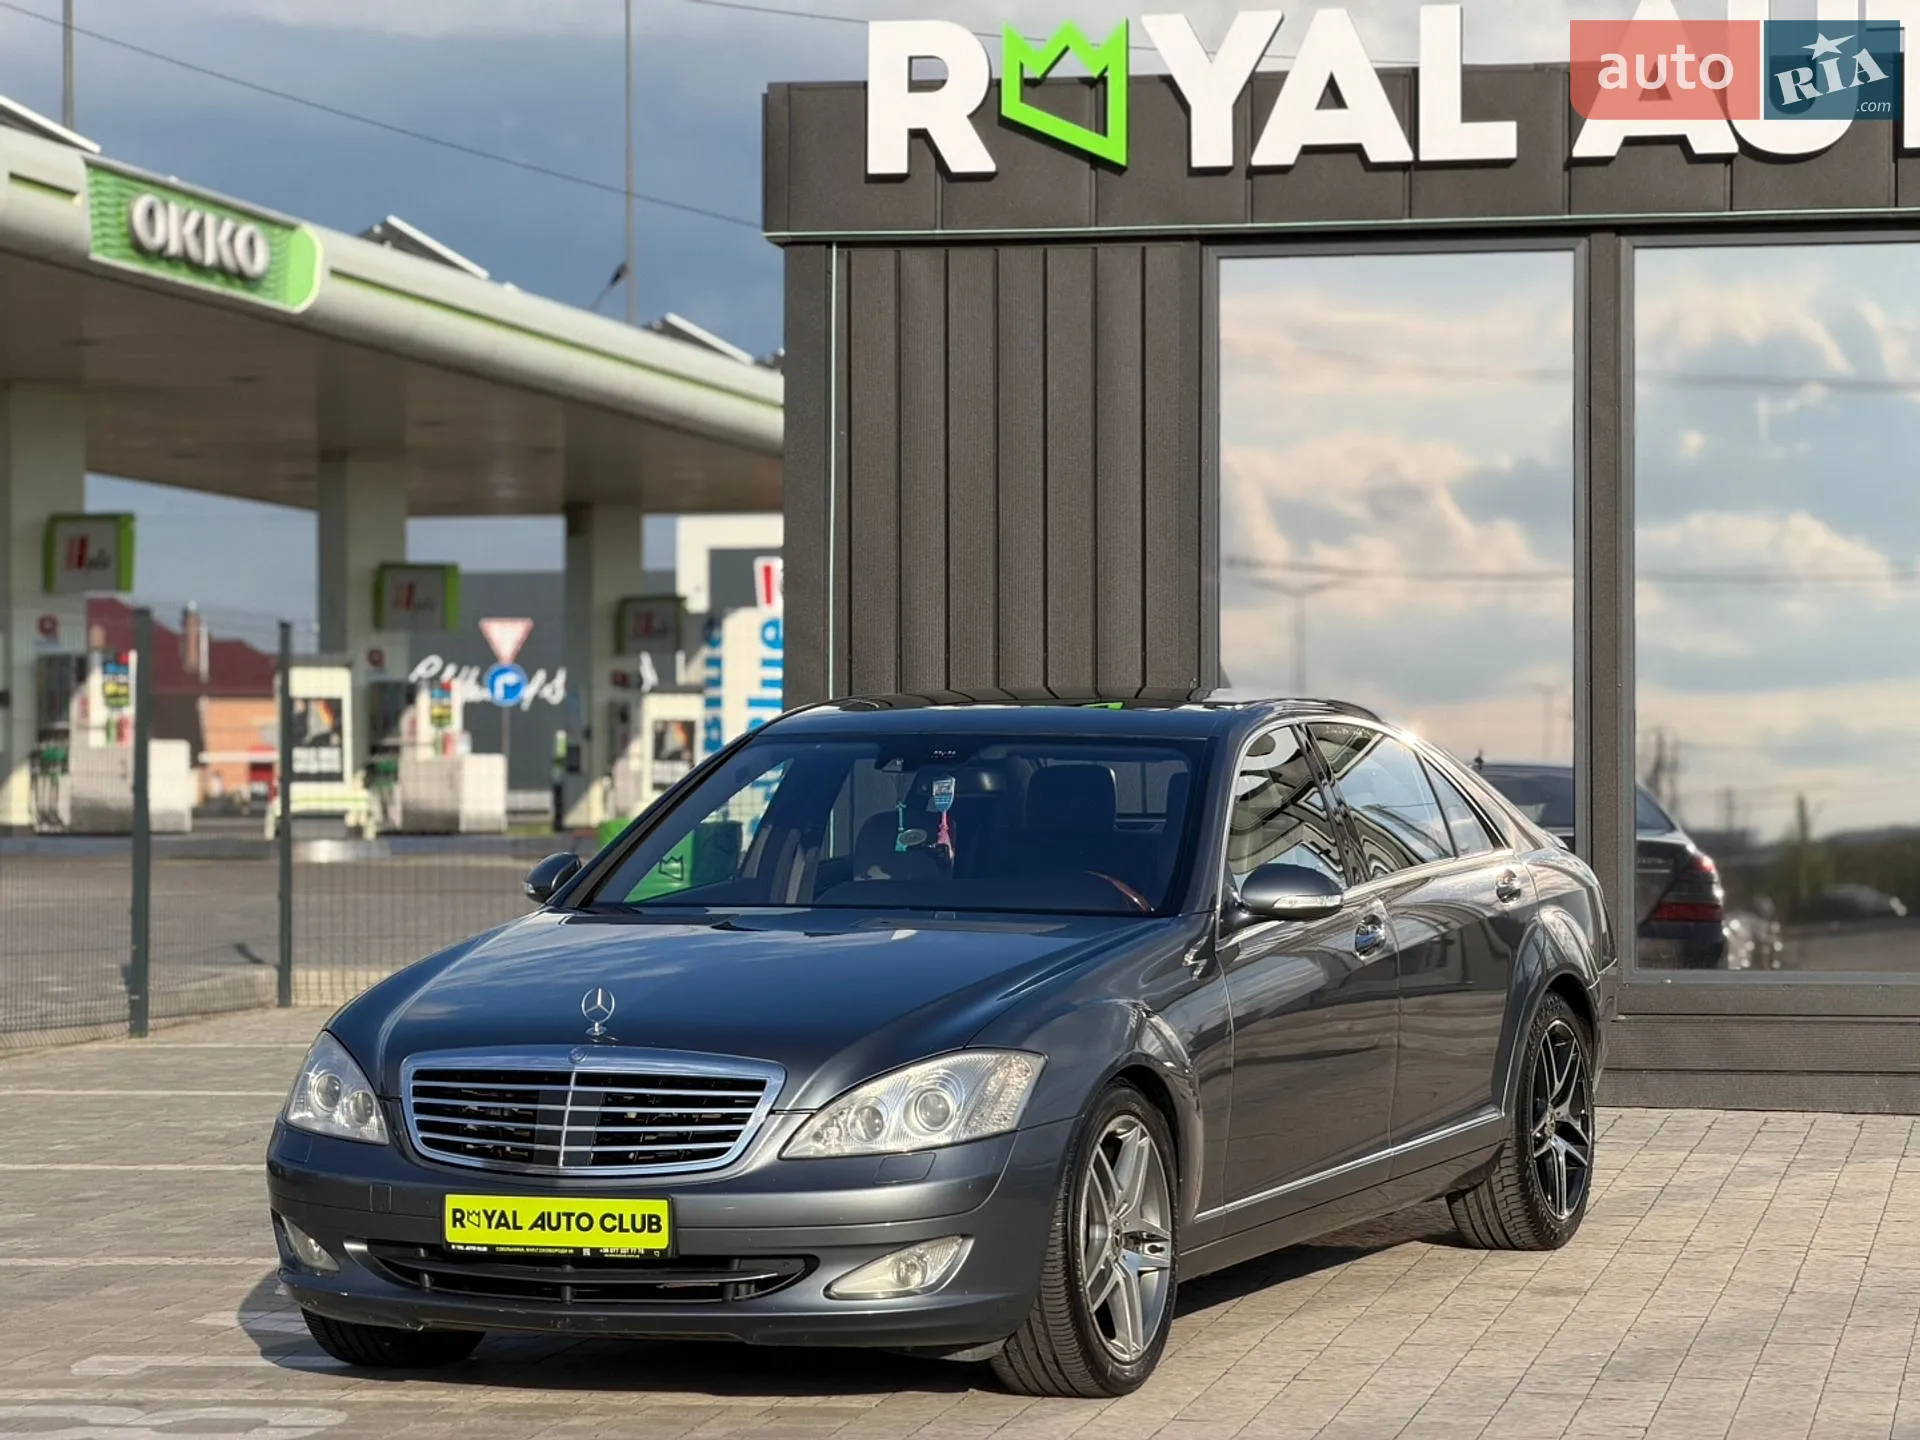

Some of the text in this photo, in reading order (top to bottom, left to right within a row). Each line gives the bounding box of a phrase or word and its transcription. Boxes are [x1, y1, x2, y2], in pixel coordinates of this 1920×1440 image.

[132, 194, 269, 278] OKKO
[528, 1211, 594, 1232] AUTO
[599, 1212, 663, 1234] CLUB
